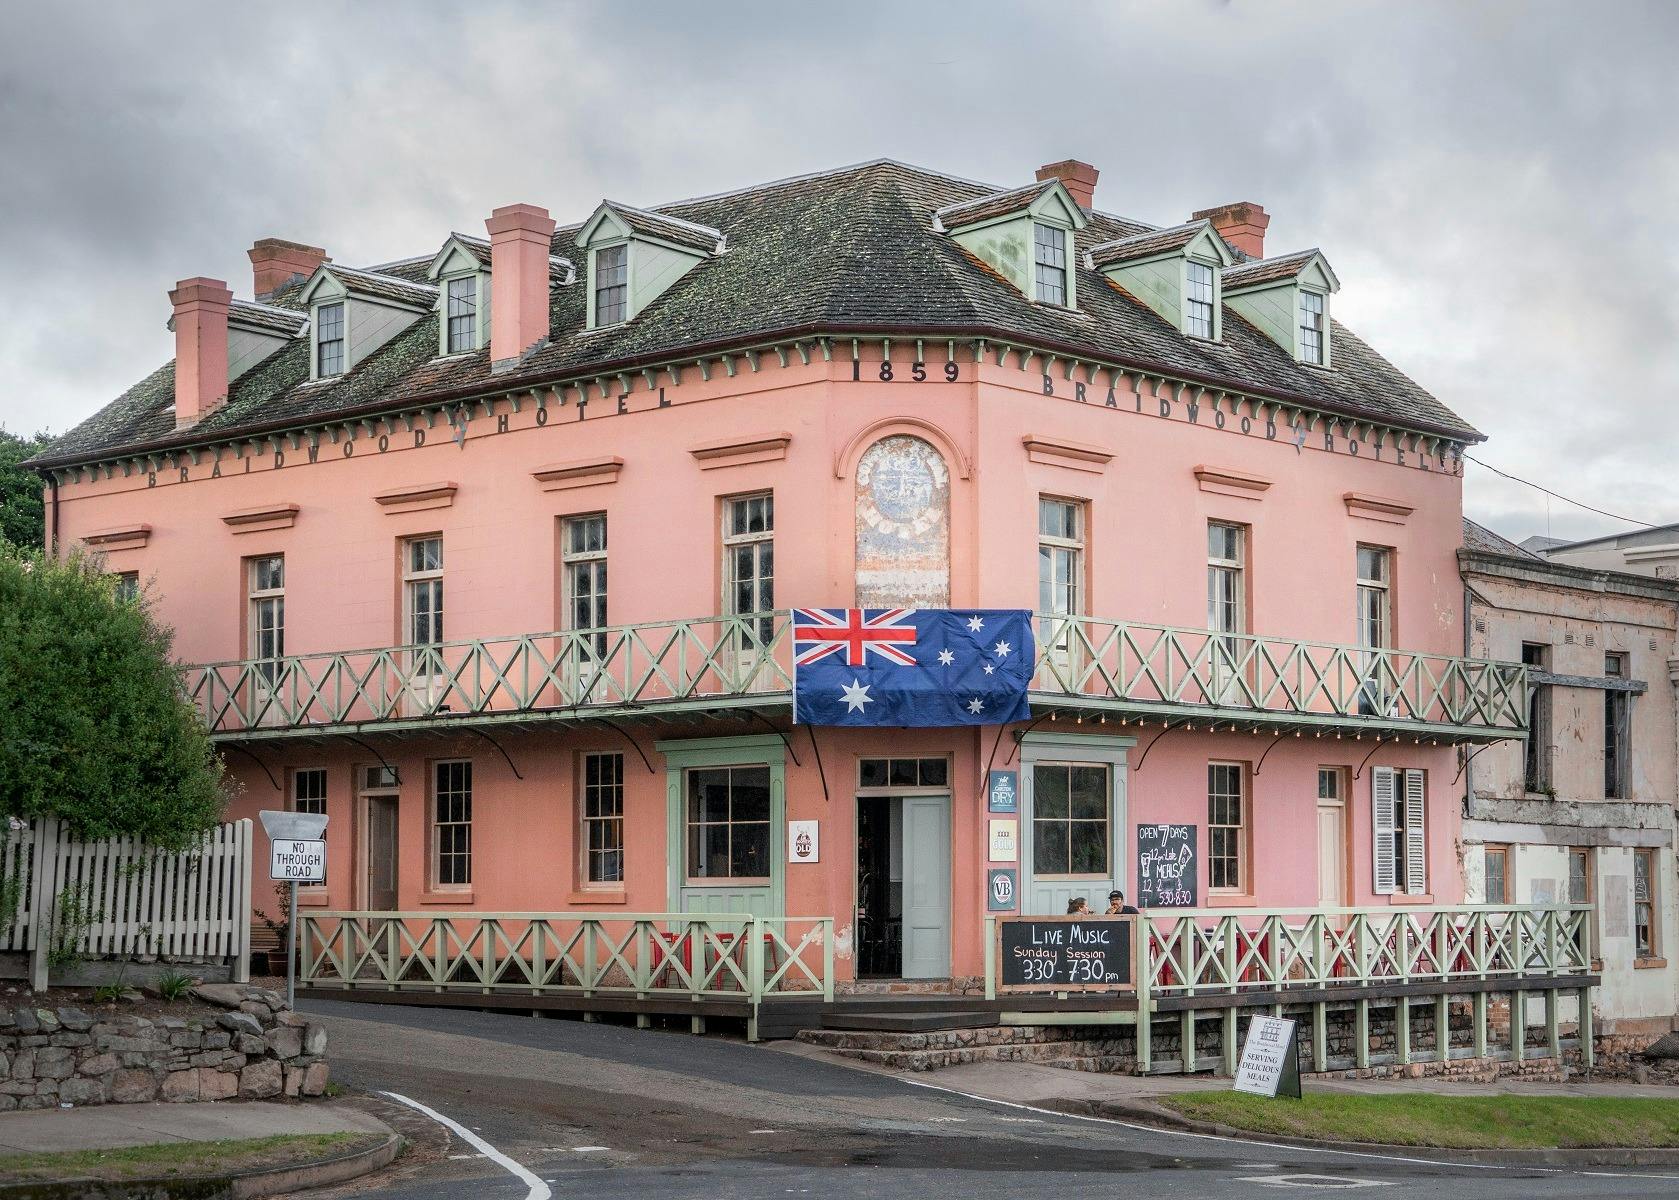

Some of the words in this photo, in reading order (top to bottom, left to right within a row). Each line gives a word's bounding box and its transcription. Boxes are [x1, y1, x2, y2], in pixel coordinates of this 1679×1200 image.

[852, 361, 960, 383] 1859
[1043, 374, 1277, 440] BRAIDWOOD
[1324, 433, 1419, 470] HOTEL
[148, 429, 426, 488] BRAIDWOOD
[497, 387, 672, 433] HOTEL
[992, 791, 1015, 804] DRY
[1139, 827, 1158, 839] OPEN
[1158, 825, 1170, 847] 7
[1169, 826, 1189, 840] DAYS
[292, 842, 305, 853] NO
[796, 845, 811, 853] OLD
[276, 853, 321, 866] THROUGH
[285, 865, 312, 877] ROAD
[1156, 862, 1180, 879] MEALS
[996, 883, 1010, 896] VB
[1013, 945, 1058, 966] Sunday
[1066, 946, 1106, 959] Session
[1105, 972, 1119, 983] pm
[1247, 1053, 1278, 1064] SERVING
[1242, 1062, 1279, 1073] DELICIOUS
[1247, 1072, 1270, 1081] MEALS
